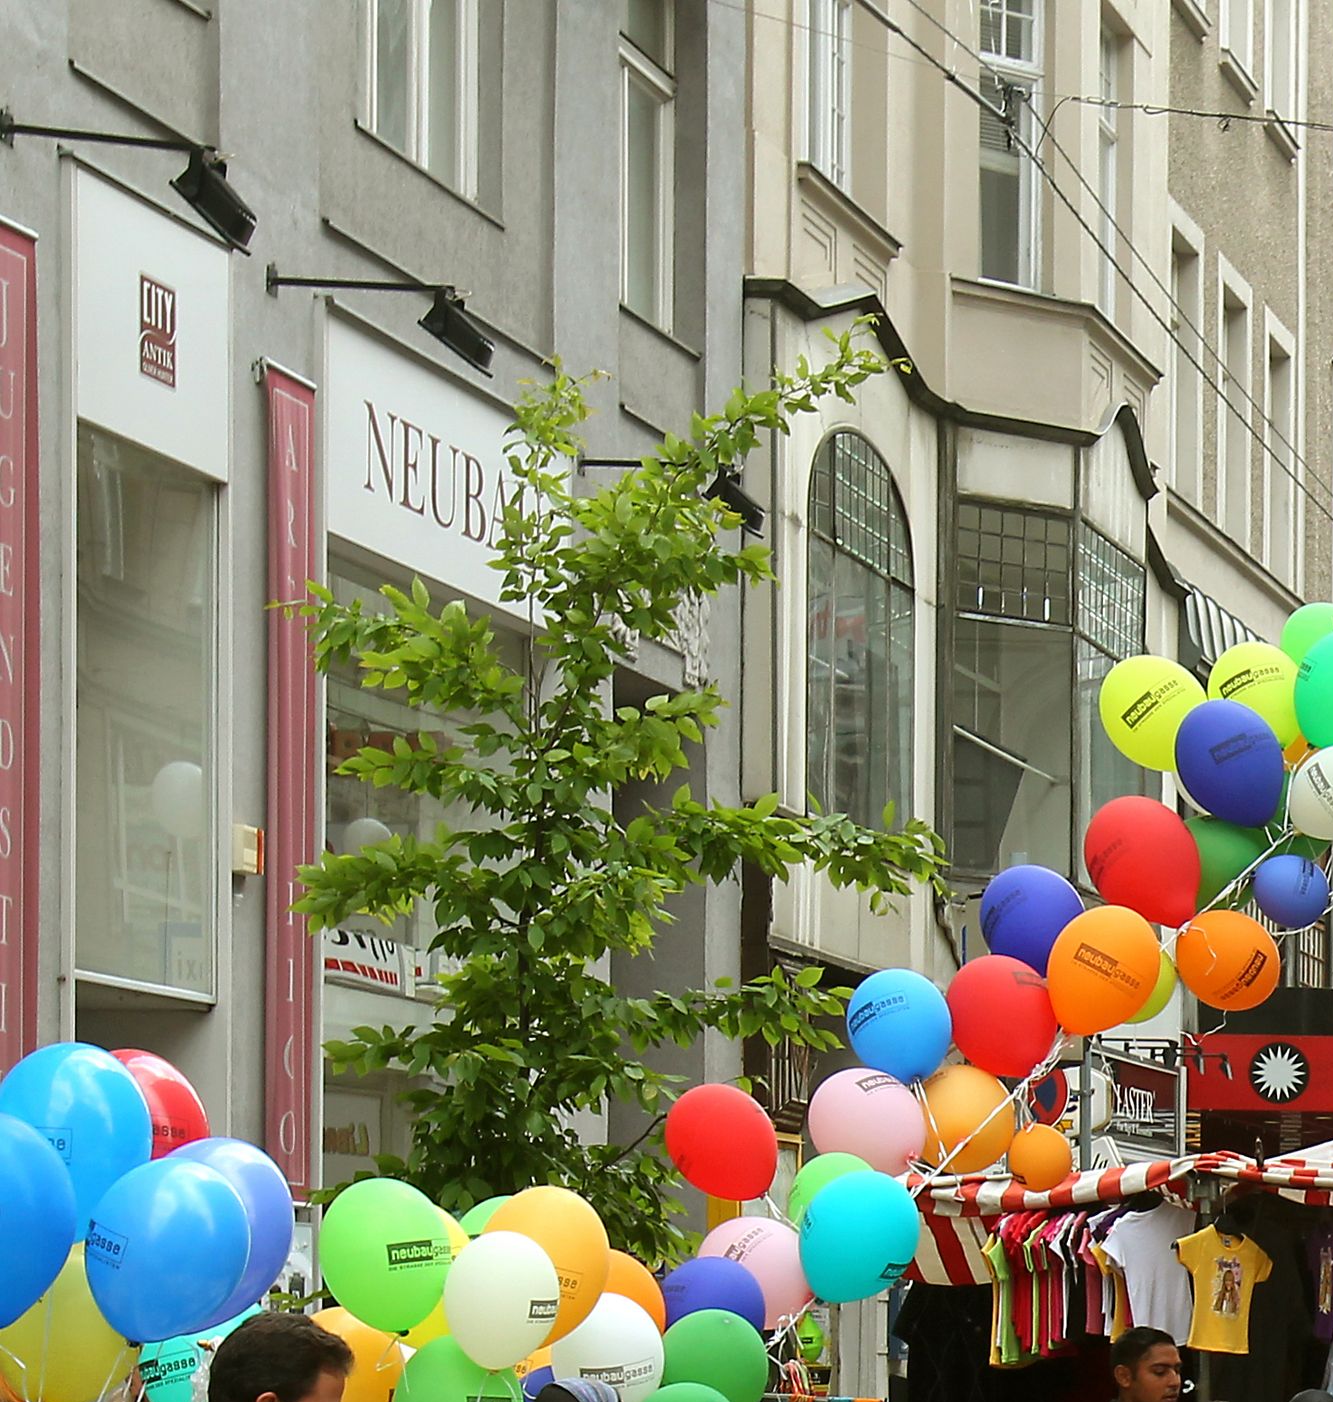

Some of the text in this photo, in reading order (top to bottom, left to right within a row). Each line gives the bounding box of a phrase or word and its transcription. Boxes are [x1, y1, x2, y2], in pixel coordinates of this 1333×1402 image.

[143, 280, 173, 334] CITY
[142, 340, 174, 370] ANTIK
[0, 279, 15, 1034] JUGENDSTI
[1125, 680, 1179, 727] neubaugasse
[1077, 946, 1140, 991] neubaugasse
